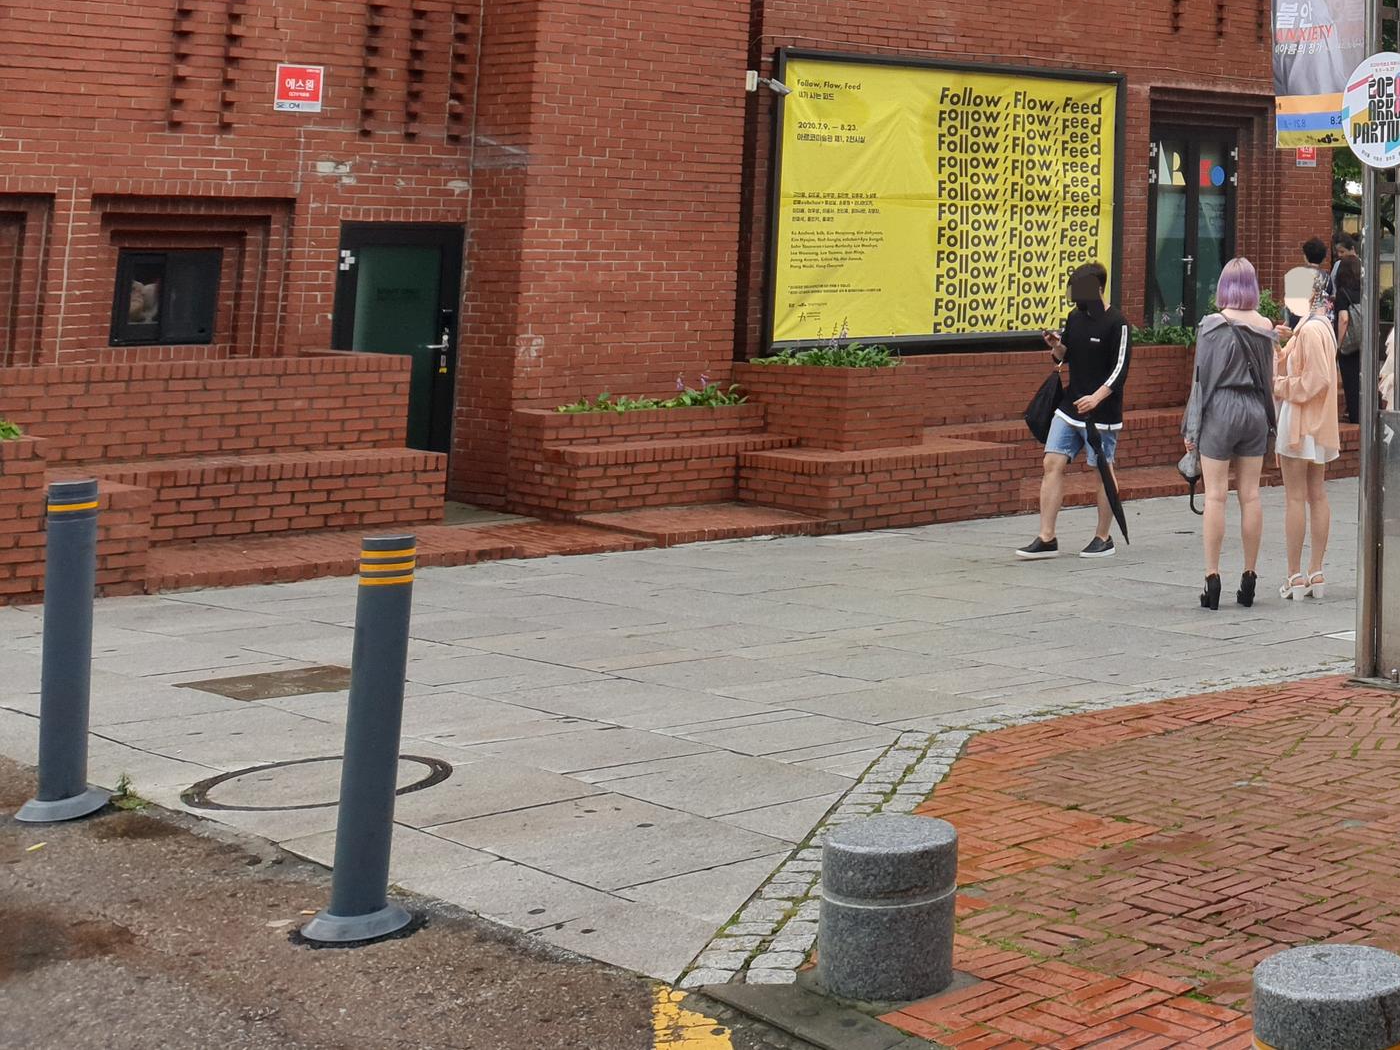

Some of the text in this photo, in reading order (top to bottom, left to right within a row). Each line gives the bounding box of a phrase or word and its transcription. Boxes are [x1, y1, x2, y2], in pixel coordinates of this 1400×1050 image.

[1276, 1, 1313, 28] 불안
[1276, 24, 1332, 43] ANXIETY
[285, 78, 314, 91] 에스원
[844, 82, 861, 90] Feed
[1062, 97, 1102, 115] Feed
[1330, 116, 1342, 125] 8.2
[1159, 140, 1225, 187] ARKO
